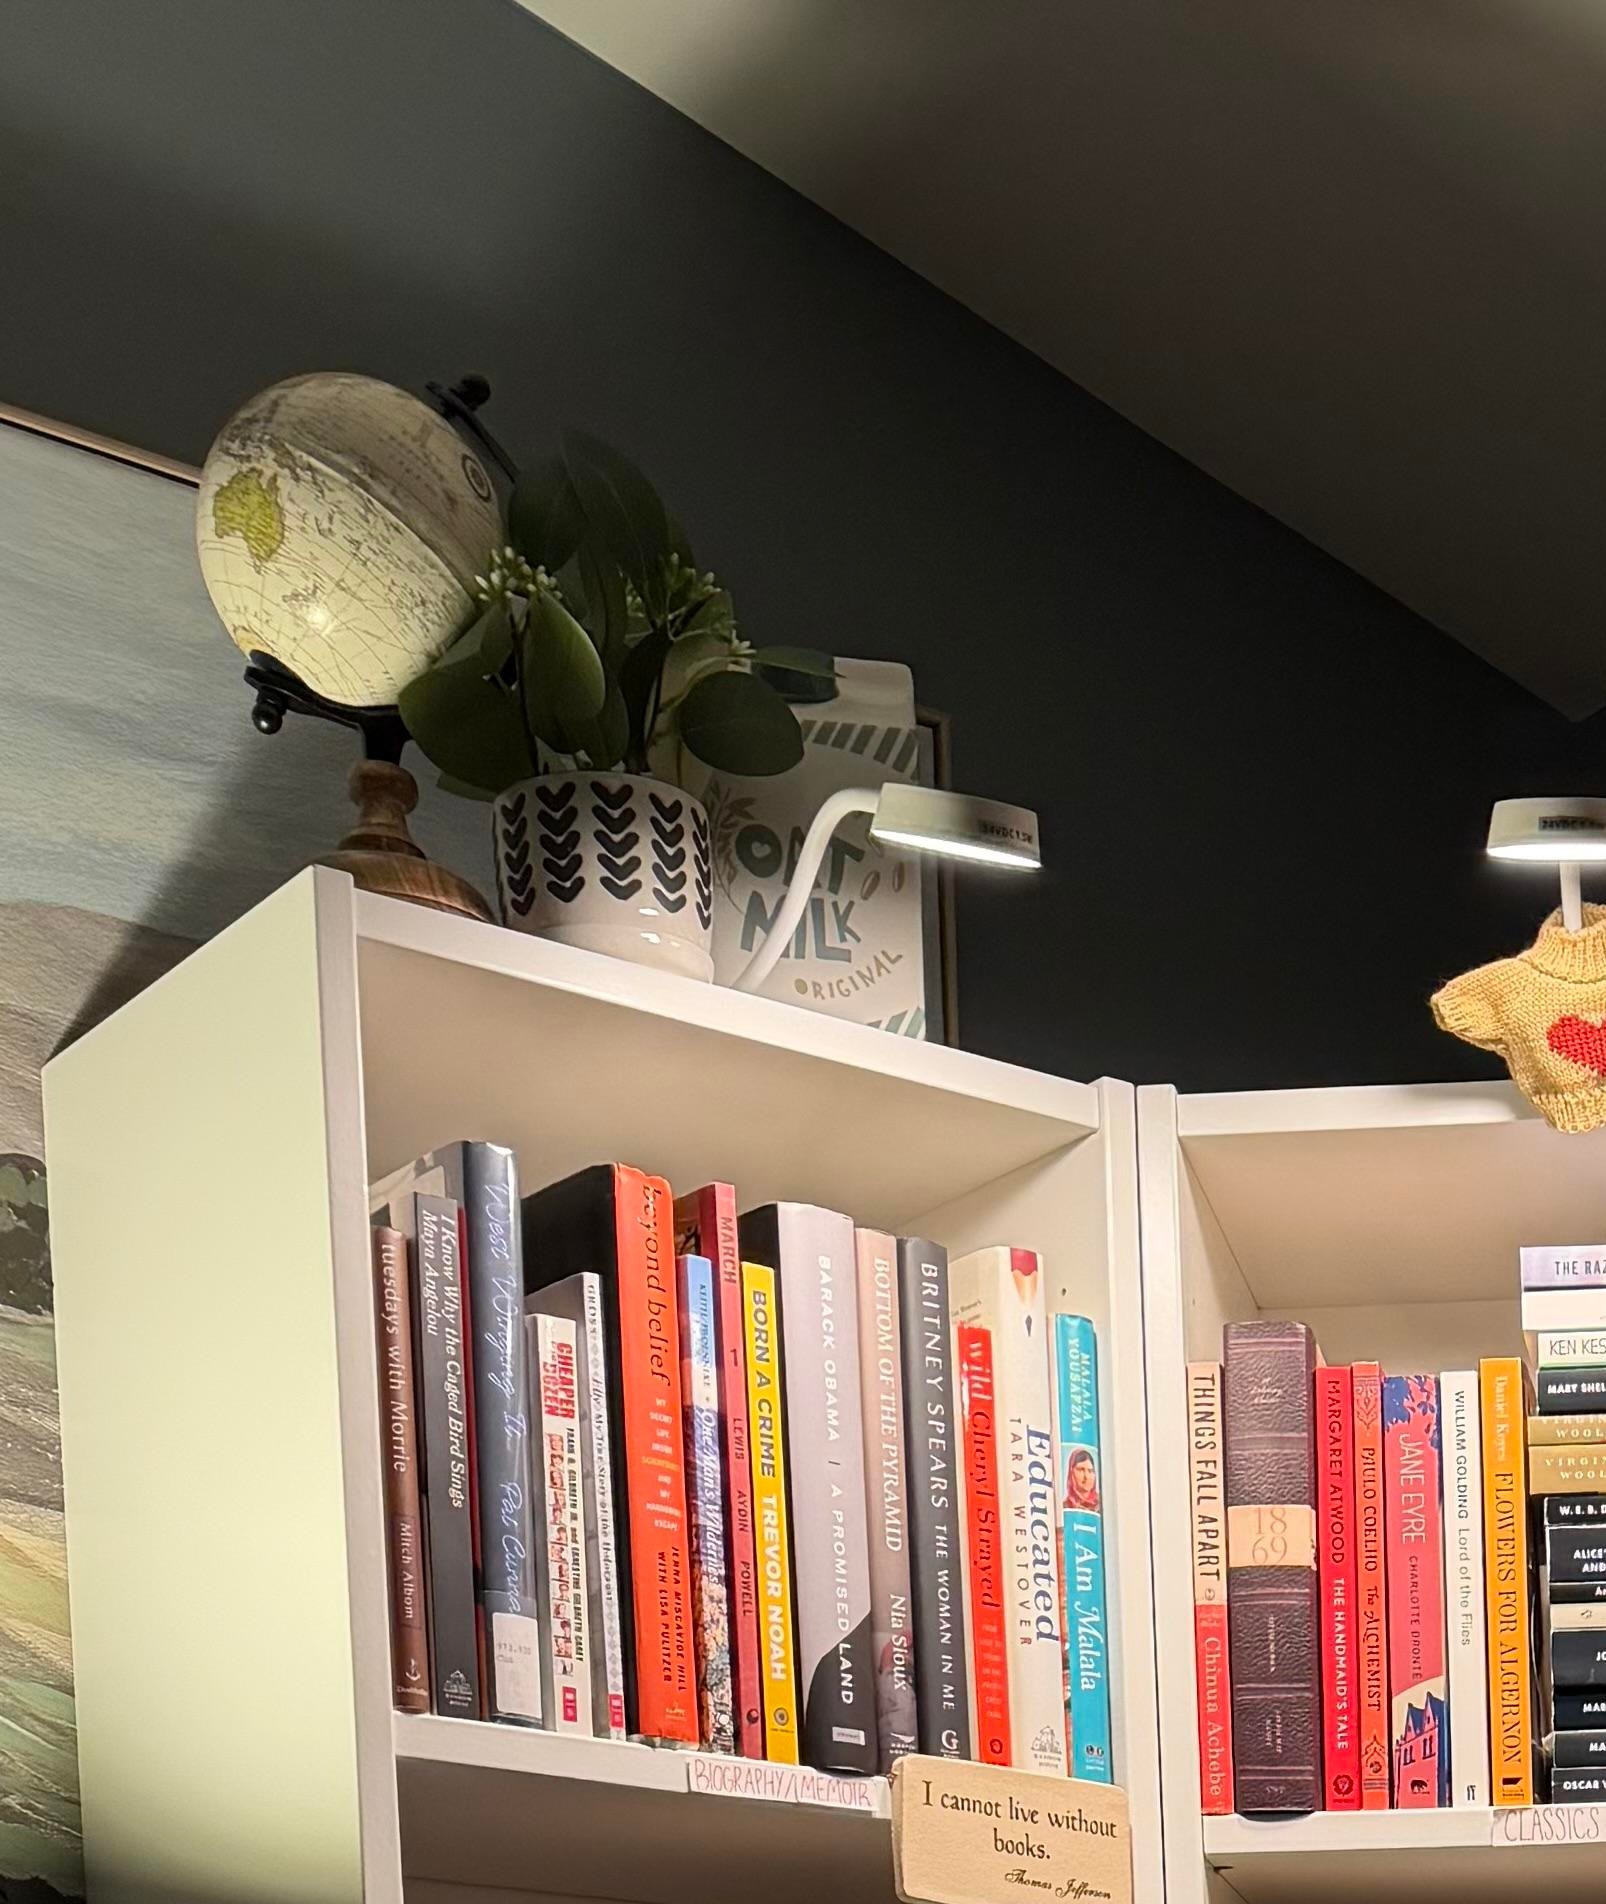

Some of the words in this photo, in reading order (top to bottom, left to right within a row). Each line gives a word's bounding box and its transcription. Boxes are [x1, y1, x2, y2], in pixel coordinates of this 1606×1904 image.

[795, 950, 903, 1000] ORIGINAL
[638, 1185, 666, 1292] beyond
[1554, 1260, 1579, 1275] THE
[752, 1290, 769, 1362] BORN
[817, 1256, 835, 1349] BARACK
[921, 1263, 942, 1392] BRITNEY
[647, 1297, 671, 1387] belief
[755, 1371, 770, 1388] A
[823, 1357, 840, 1440] OBAMA
[1193, 1373, 1216, 1452] THINGS
[758, 1399, 775, 1478] CRIME
[928, 1403, 948, 1509] SPEARS
[1400, 1434, 1425, 1488] JANE
[1195, 1461, 1216, 1506] FALL
[1403, 1495, 1426, 1545] EYRE
[762, 1495, 783, 1597] TREVOR
[1026, 1424, 1060, 1643] Educated
[1073, 1524, 1096, 1533] I
[1197, 1515, 1221, 1581] APART
[1495, 1473, 1516, 1582] FLOWERS
[1073, 1543, 1100, 1593] Am
[768, 1604, 786, 1681] NOAH
[1074, 1600, 1102, 1690] Malala
[1498, 1592, 1518, 1634] FOR
[1499, 1642, 1522, 1763] ALGERNON
[922, 1781, 932, 1806] I
[940, 1793, 1002, 1818] cannot
[1009, 1797, 1039, 1824] live
[1048, 1809, 1117, 1838] without
[993, 1829, 1051, 1860] books.
[1005, 1868, 1052, 1889] Thomas
[1056, 1878, 1111, 1900] Jefferson
